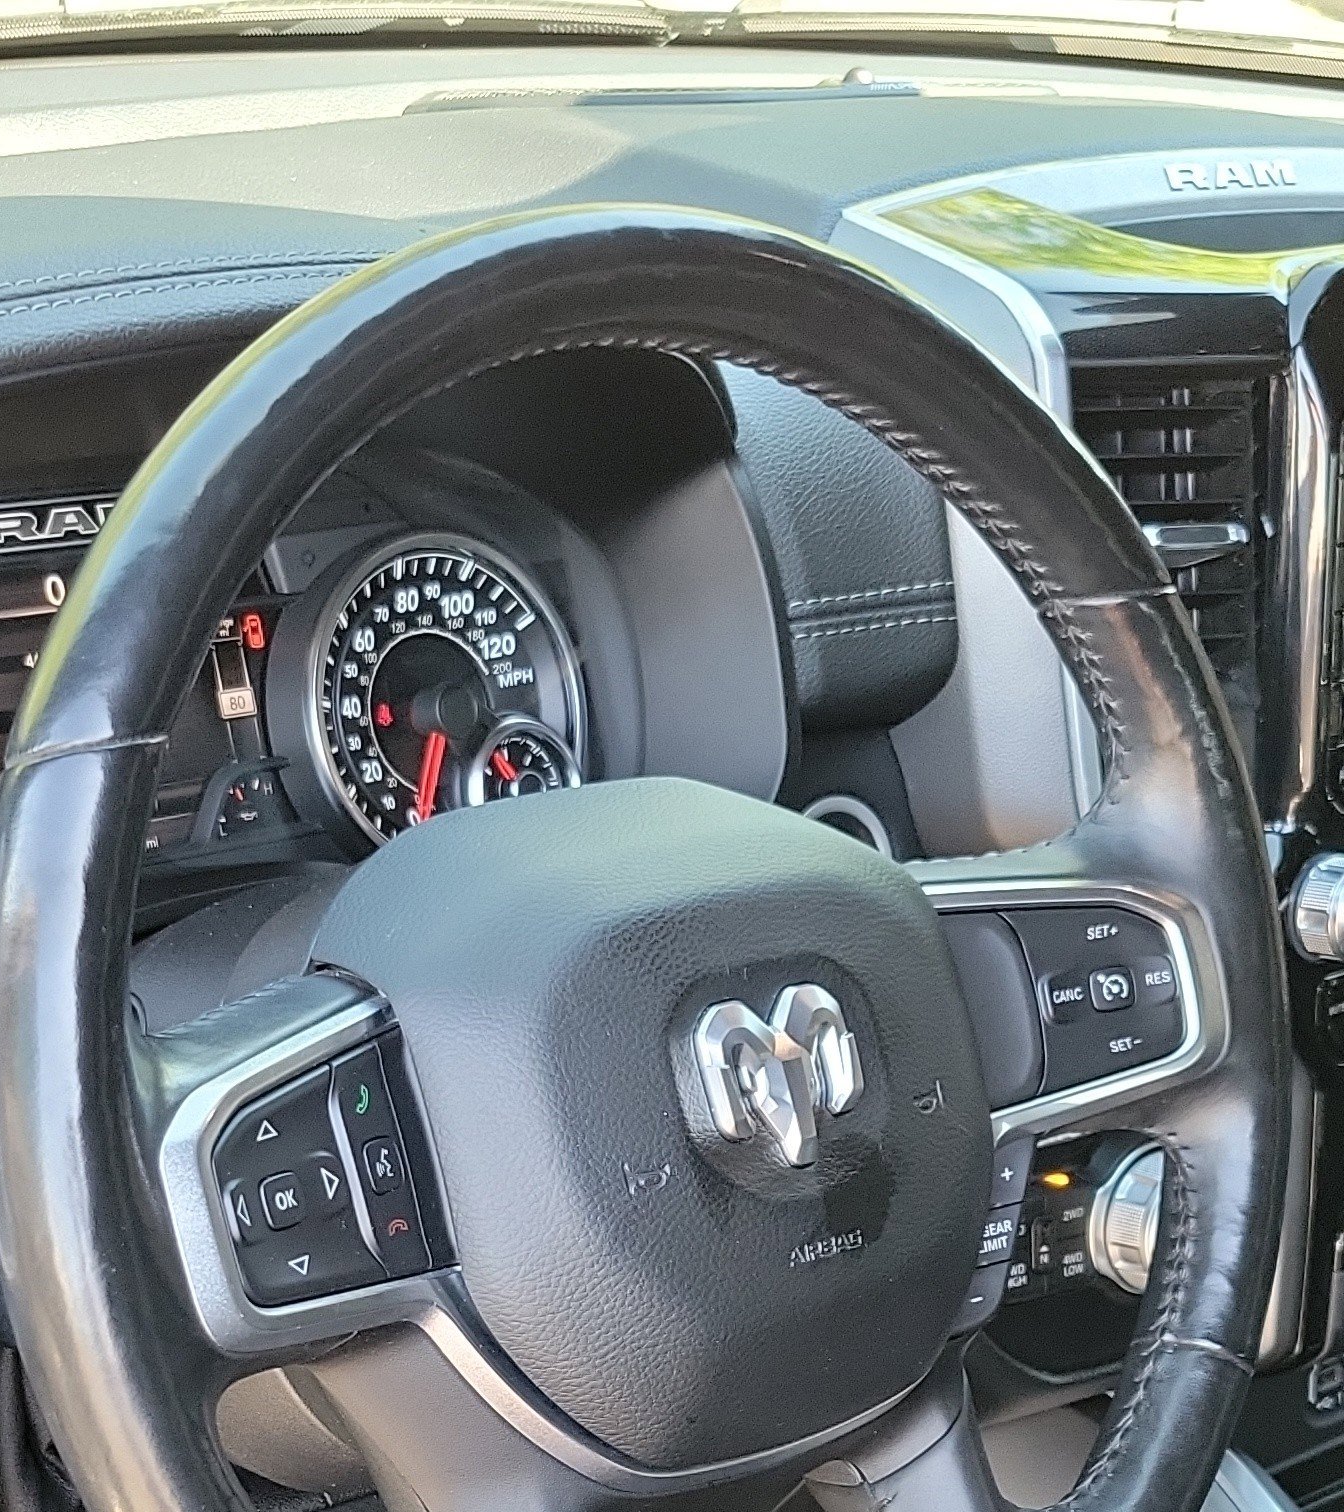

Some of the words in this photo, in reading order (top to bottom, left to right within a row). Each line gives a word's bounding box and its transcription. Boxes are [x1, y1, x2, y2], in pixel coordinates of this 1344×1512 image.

[1163, 159, 1298, 192] RAM
[43, 574, 66, 606] 0
[424, 582, 441, 600] 90
[395, 587, 419, 613] 80
[440, 590, 474, 619] 100
[374, 605, 389, 623] 70
[417, 614, 433, 627] 140
[474, 608, 497, 626] 110
[391, 621, 406, 633] 120
[467, 630, 485, 642] 180
[353, 627, 375, 652] 60
[480, 632, 516, 660] 120
[364, 652, 378, 664] 100
[343, 662, 358, 678] 50
[492, 662, 512, 674] 200
[498, 668, 534, 689] MPH
[229, 694, 246, 711] 80
[342, 697, 361, 719] 40
[347, 734, 361, 751] 30
[361, 761, 383, 783] 20
[263, 781, 273, 795] H
[381, 794, 396, 811] 10
[1145, 971, 1171, 987] RES
[1052, 987, 1084, 1004] CANC
[275, 1188, 298, 1210] OK
[789, 1229, 863, 1268] AIRBAG
